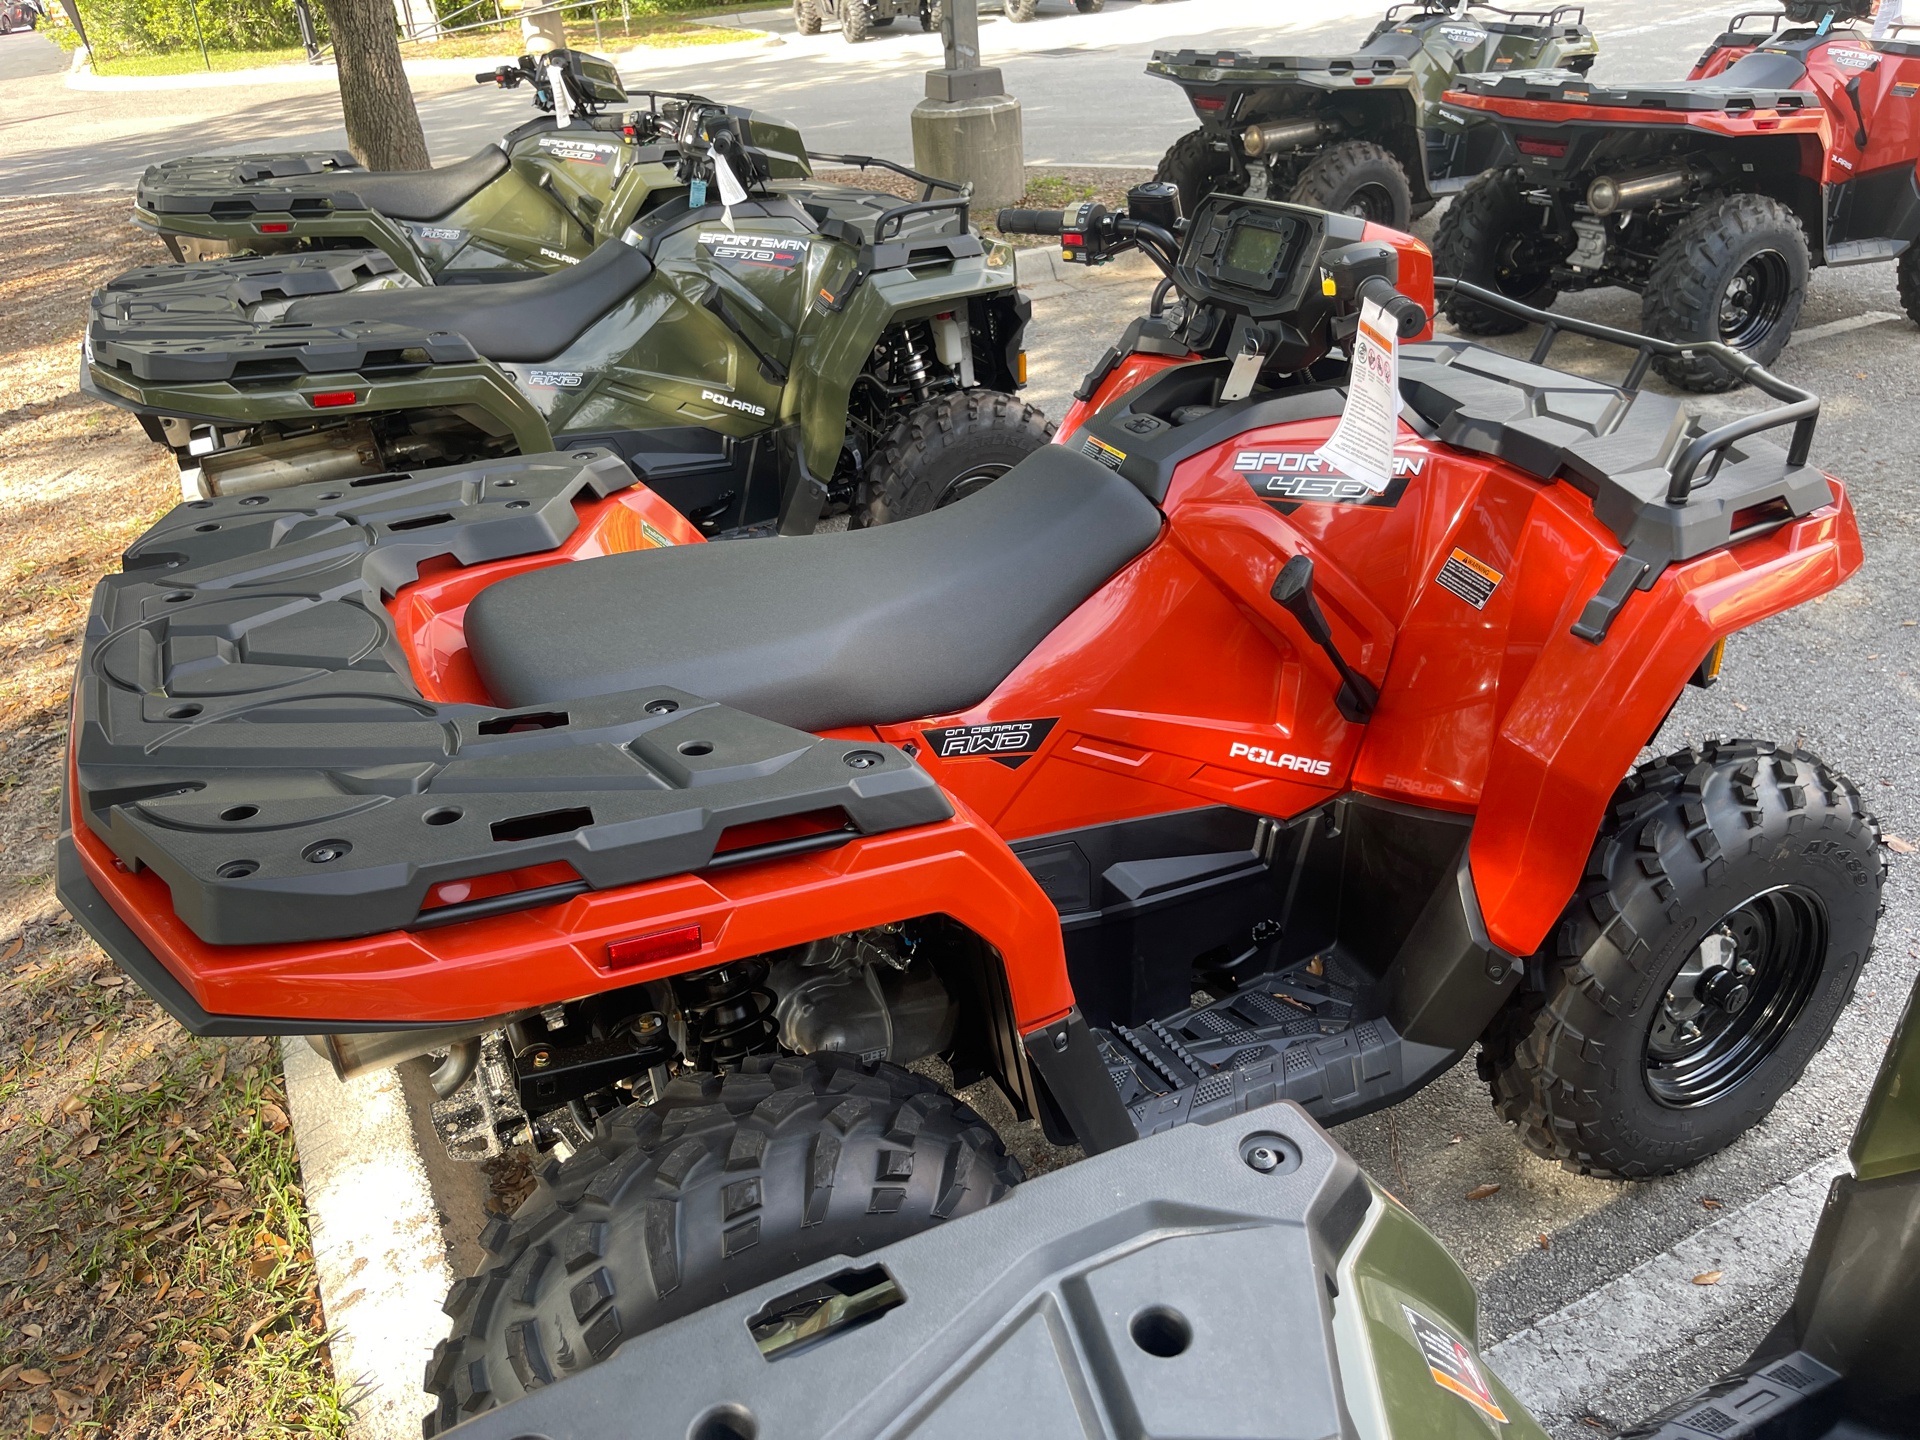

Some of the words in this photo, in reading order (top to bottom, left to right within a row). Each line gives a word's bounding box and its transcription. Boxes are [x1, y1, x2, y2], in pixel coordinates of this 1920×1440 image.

[1440, 27, 1488, 39] SPORTSMAN
[1827, 48, 1883, 62] SPORTSMAN
[1837, 57, 1868, 68] 450
[539, 138, 618, 154] SPORTSMAN
[551, 148, 596, 160] 450
[421, 230, 460, 240] AWD
[698, 232, 811, 252] SPORTSMAN
[714, 246, 775, 261] 570
[528, 374, 582, 387] AWD
[701, 389, 766, 417] POLARIS
[1233, 452, 1424, 476] SPORAN
[1266, 476, 1370, 499] 450
[1467, 558, 1490, 576] WARNING
[945, 728, 965, 737] ON
[971, 723, 1032, 734] DEMAND
[941, 731, 1029, 757] AWD
[1229, 741, 1332, 776] POLARIS
[1800, 839, 1868, 887] AT489
